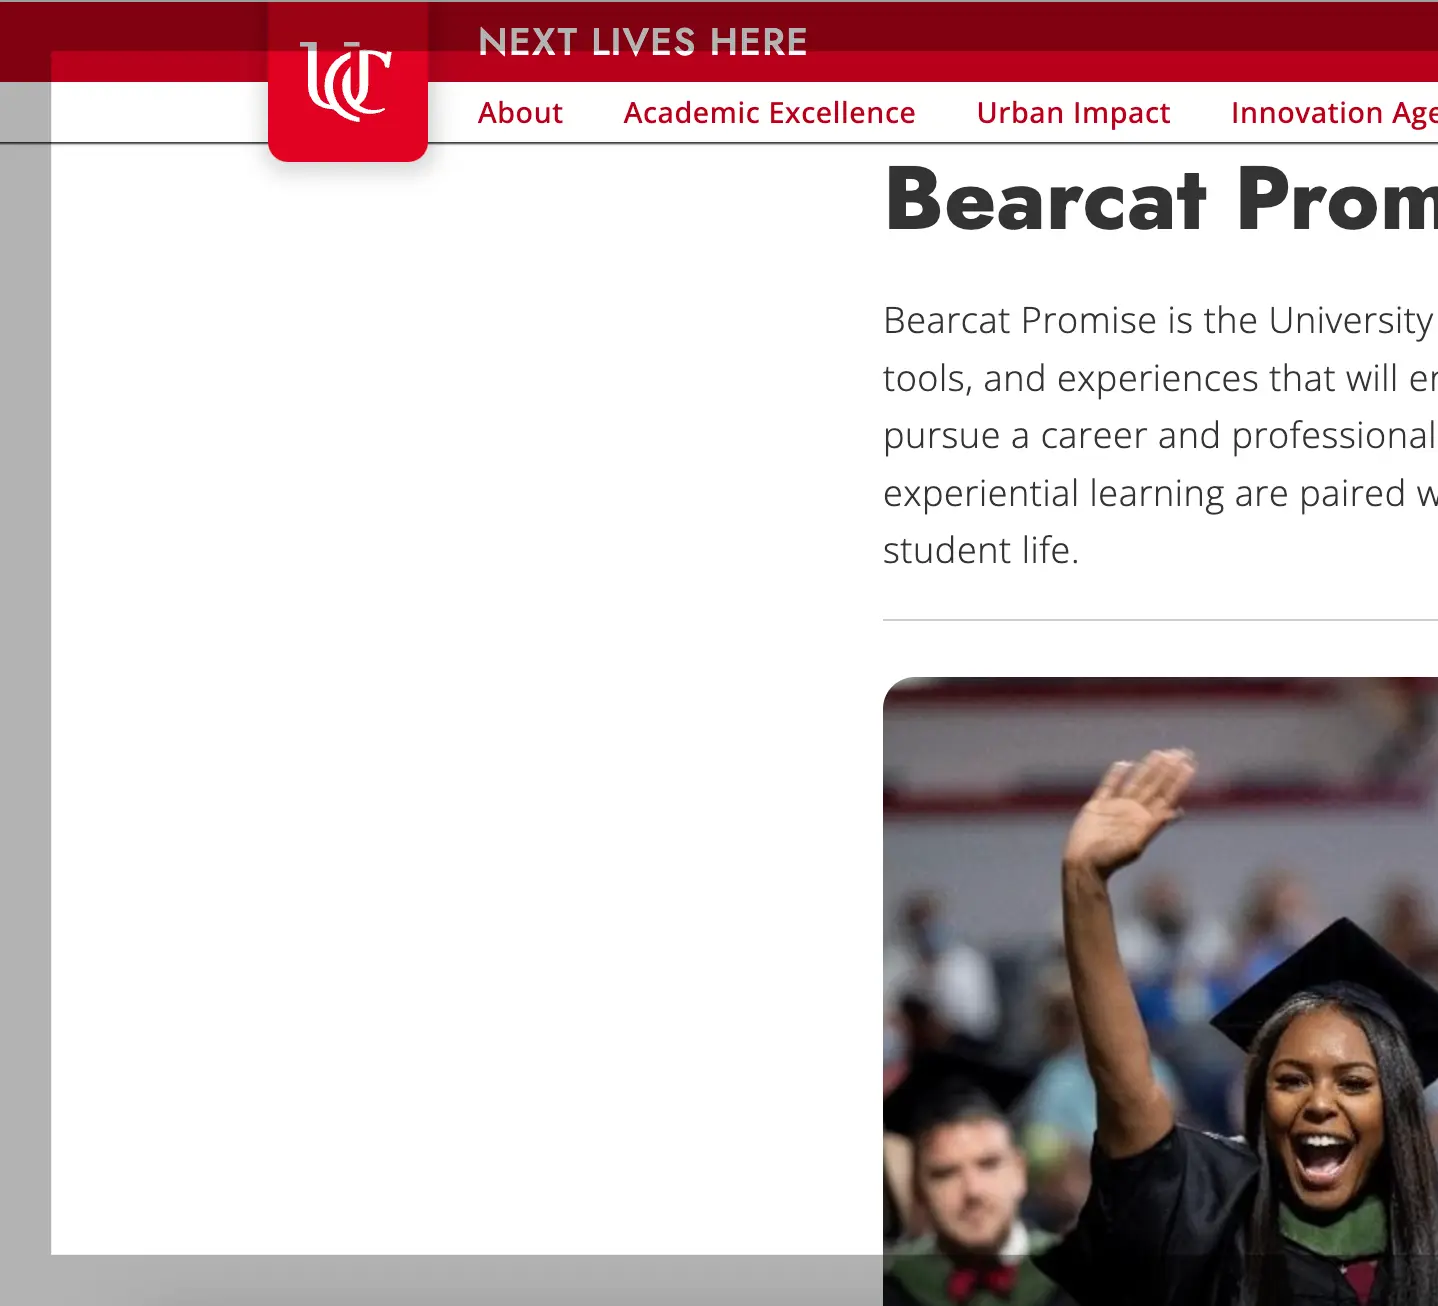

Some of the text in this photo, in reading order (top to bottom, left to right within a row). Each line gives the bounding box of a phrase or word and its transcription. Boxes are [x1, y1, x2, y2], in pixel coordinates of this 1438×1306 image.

[479, 26, 807, 58] NEXT LIVES HERE
[477, 99, 564, 125] About
[622, 99, 916, 125] Academic Excellence
[978, 99, 1171, 131] Urban Impact
[1232, 100, 1383, 125] Innovation
[888, 165, 1207, 231] Bearcat
[885, 306, 1011, 335] Bearcat
[1023, 305, 1156, 335] Promise
[1169, 305, 1193, 335] is
[1203, 304, 1257, 335] the
[1270, 305, 1434, 343] University
[882, 362, 972, 397] tools,
[984, 362, 1045, 393] and
[1058, 363, 1258, 401] experiences
[1268, 362, 1336, 393] that
[1345, 362, 1396, 392] will
[885, 427, 1000, 458] pursue
[1011, 427, 1029, 450] a
[1041, 427, 1148, 450] career
[1158, 419, 1219, 450] and
[1233, 419, 1435, 458] professional
[884, 477, 1077, 516] experiential
[1091, 477, 1225, 516] learning
[1235, 485, 1288, 508] are
[1301, 477, 1404, 516] paired
[883, 534, 1078, 565] student life.
